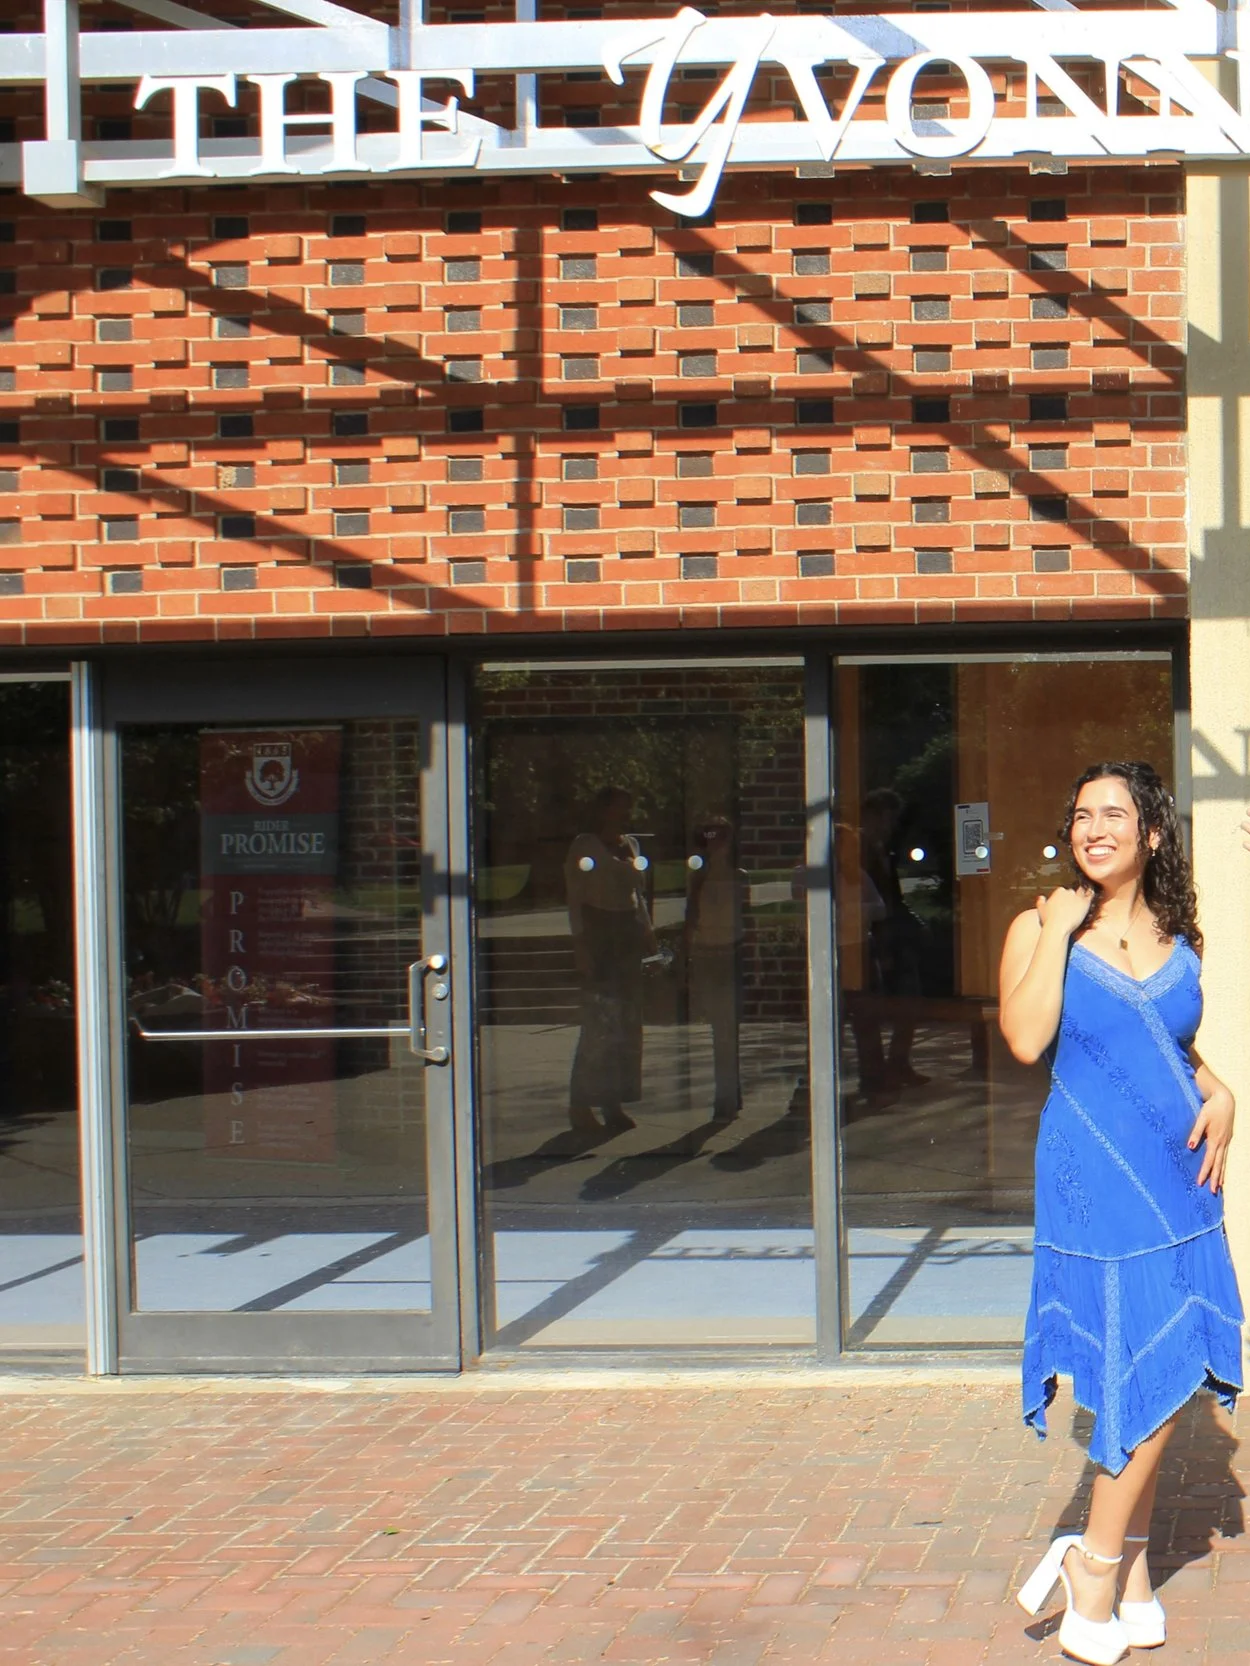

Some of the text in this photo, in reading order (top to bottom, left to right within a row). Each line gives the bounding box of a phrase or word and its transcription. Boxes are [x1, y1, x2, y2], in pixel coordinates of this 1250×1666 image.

[134, 69, 483, 178] THE
[253, 820, 291, 832] RIDER
[220, 832, 326, 856] PROMISE
